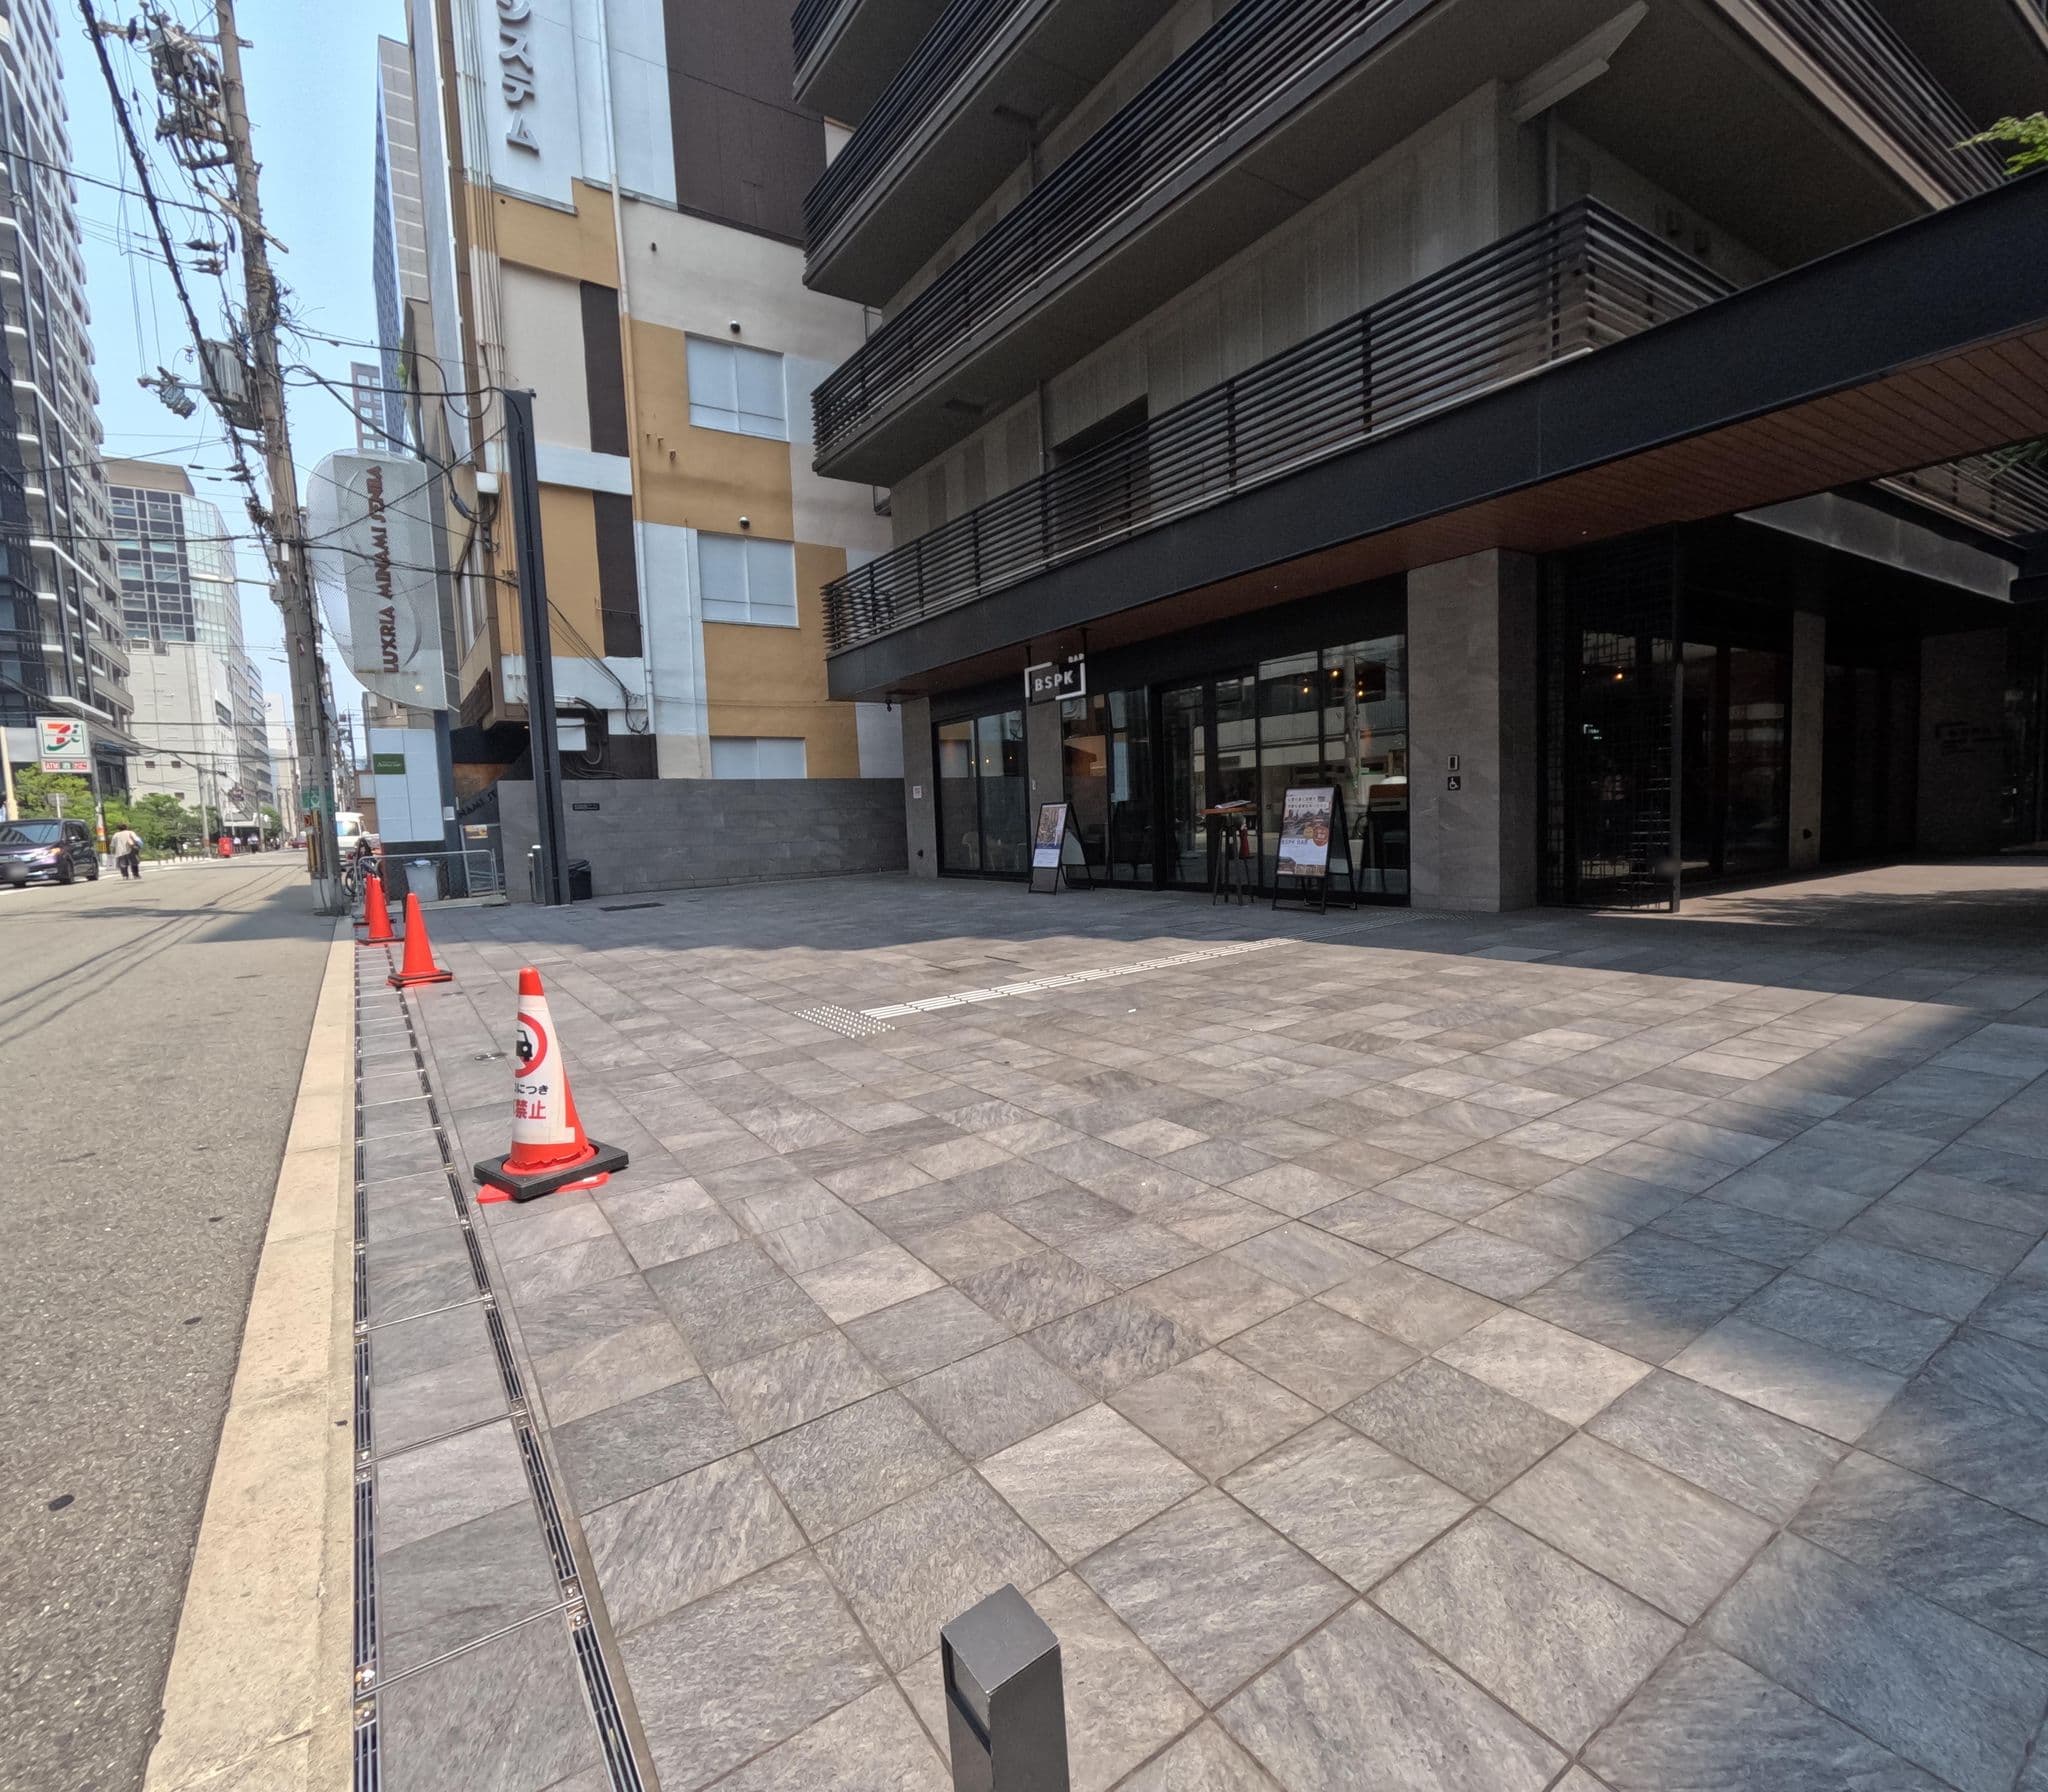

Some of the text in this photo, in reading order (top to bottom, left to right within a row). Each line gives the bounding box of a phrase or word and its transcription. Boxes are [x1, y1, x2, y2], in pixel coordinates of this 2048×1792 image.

[371, 526, 393, 600] MINAMI
[379, 605, 399, 673] LUXRIA
[1034, 670, 1075, 692] BSPK
[514, 1083, 549, 1096] につき
